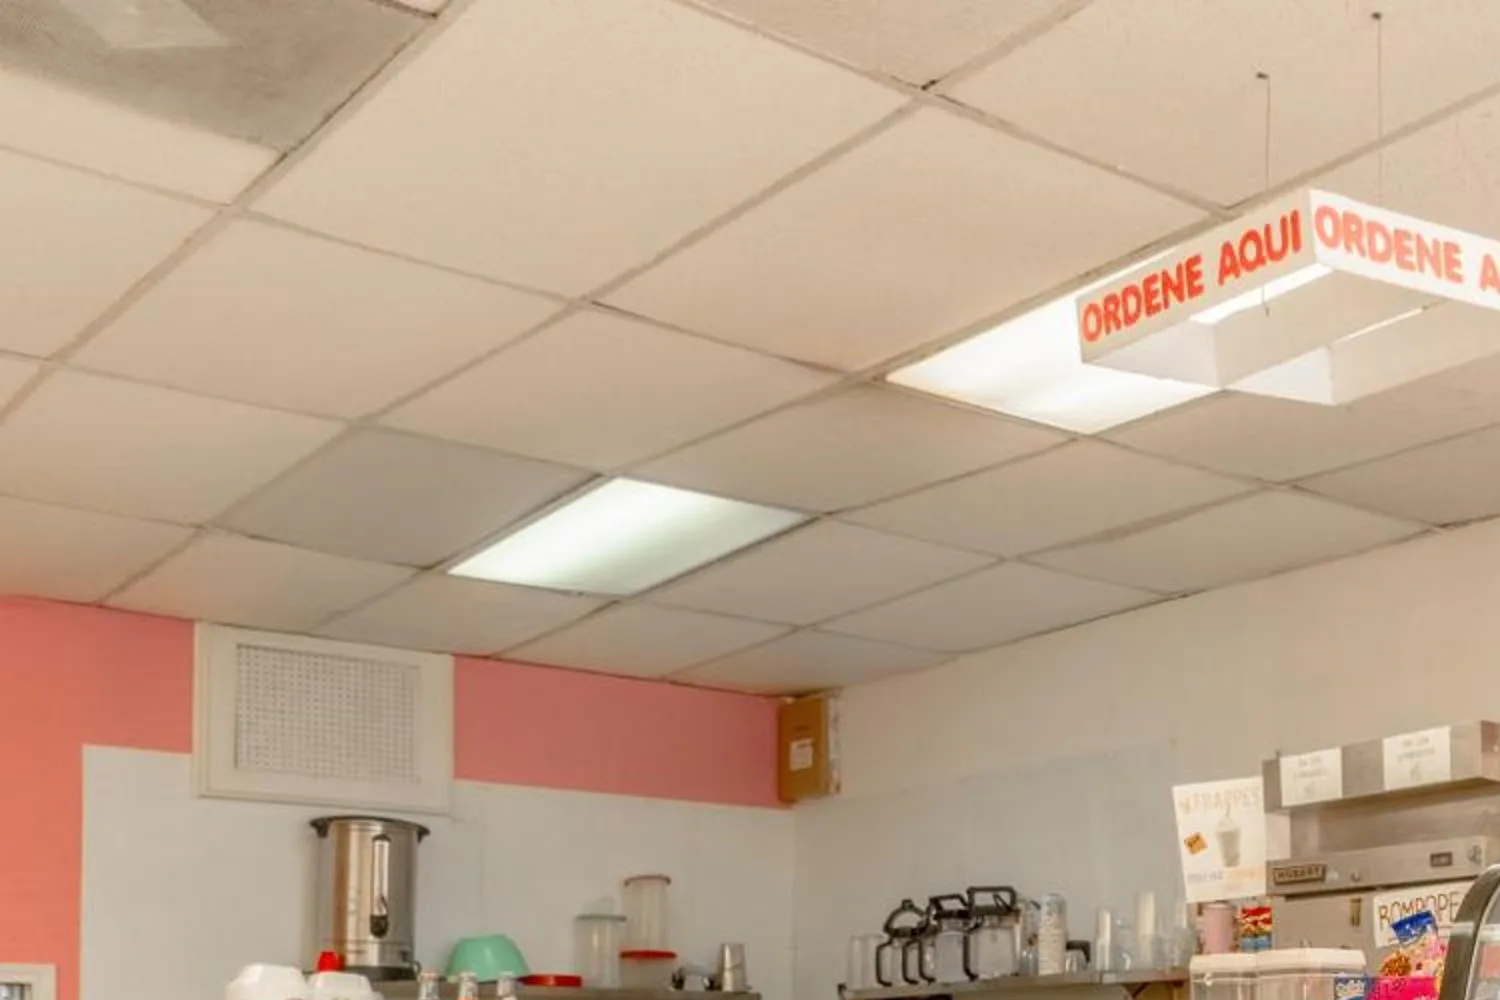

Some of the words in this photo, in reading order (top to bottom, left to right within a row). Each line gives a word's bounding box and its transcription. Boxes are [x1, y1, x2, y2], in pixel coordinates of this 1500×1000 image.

[1081, 254, 1205, 343] ORDENE
[1216, 208, 1302, 286] AQUI
[1313, 204, 1466, 284] ORDENE
